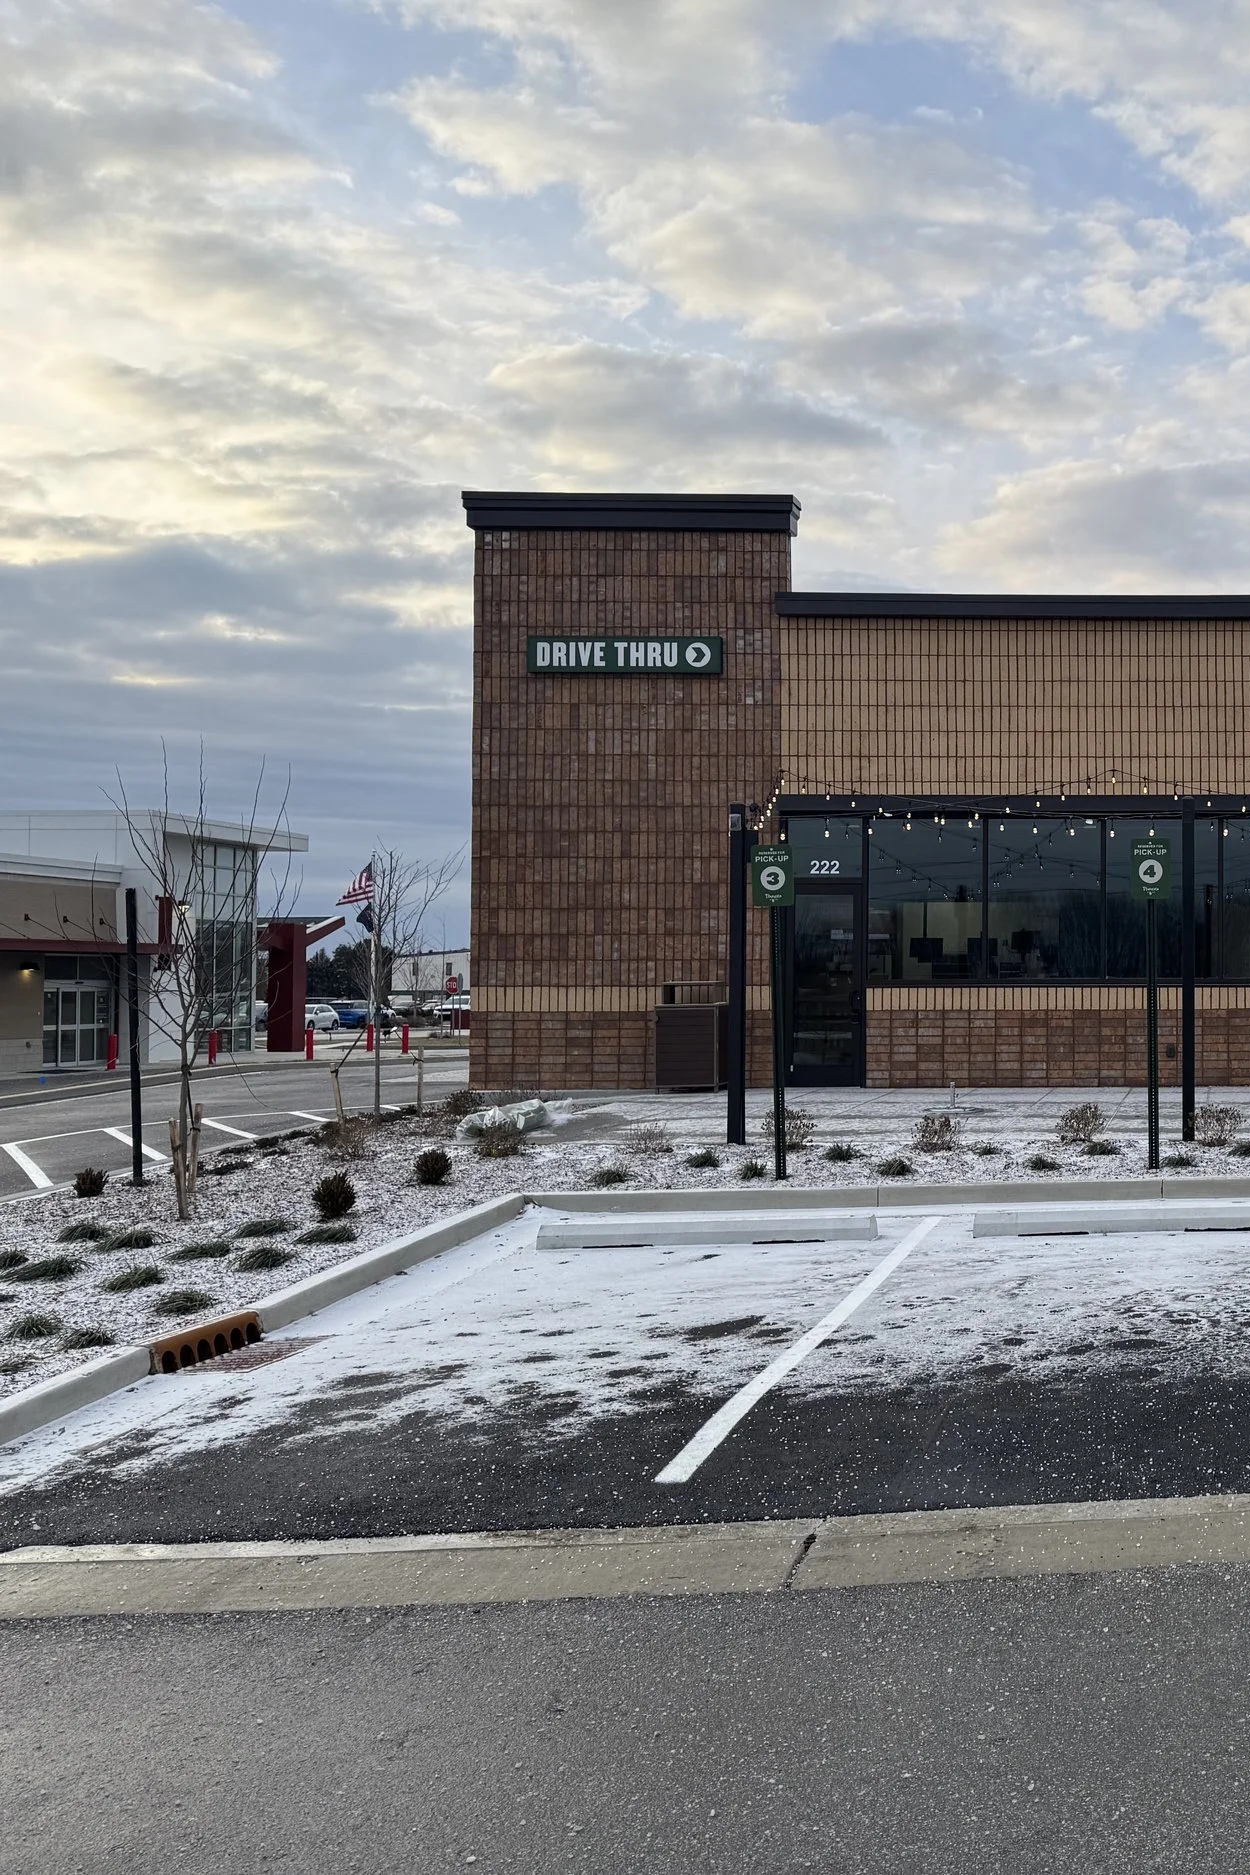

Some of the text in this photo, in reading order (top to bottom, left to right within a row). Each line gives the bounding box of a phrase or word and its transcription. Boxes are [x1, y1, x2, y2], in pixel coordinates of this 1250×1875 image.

[536, 641, 678, 668] DRIVE THRU
[755, 855, 789, 863] PICK-UP
[810, 860, 840, 875] 222
[1143, 864, 1156, 878] 4
[766, 871, 780, 886] 3
